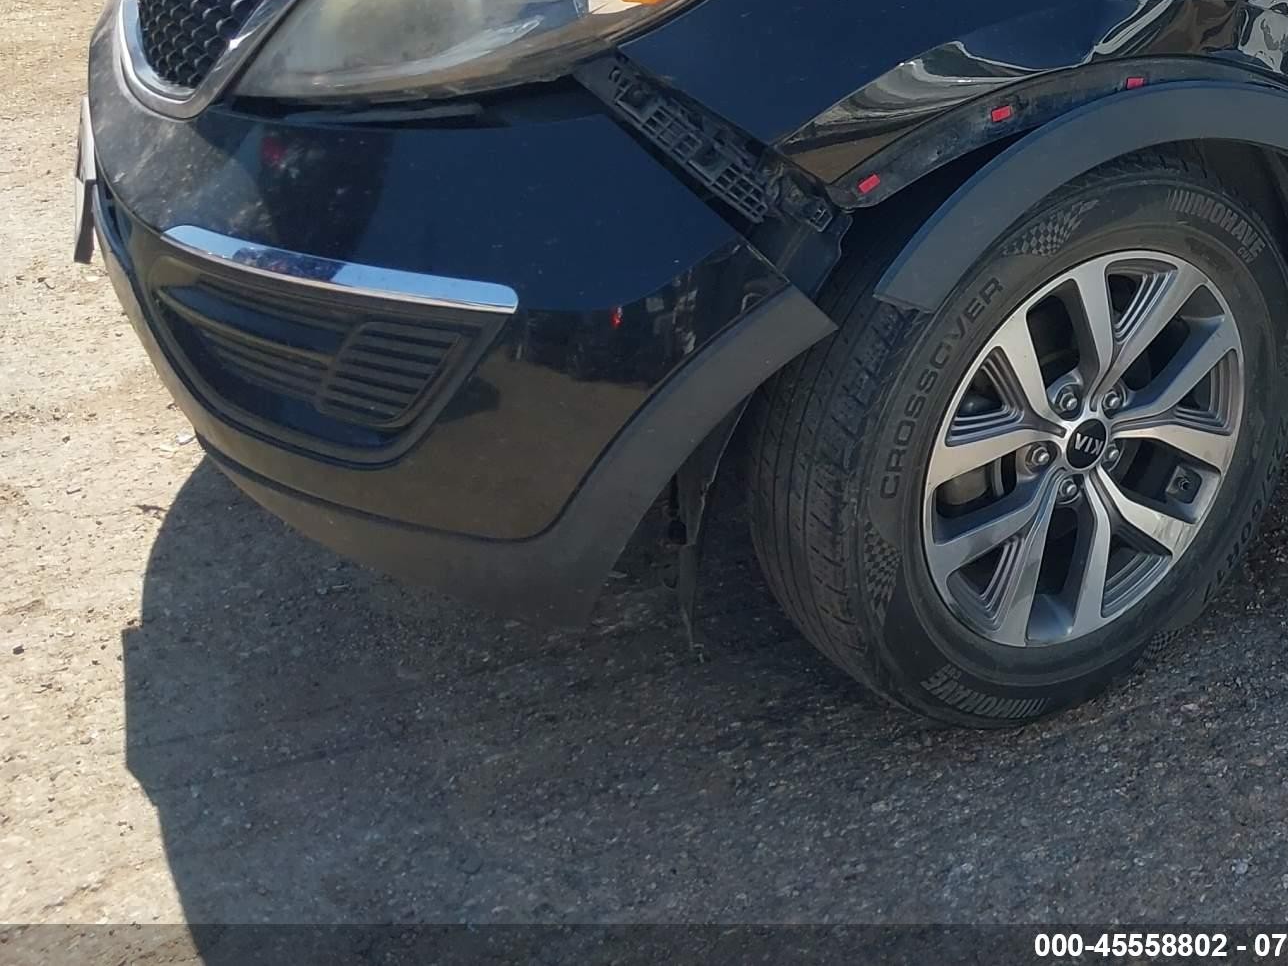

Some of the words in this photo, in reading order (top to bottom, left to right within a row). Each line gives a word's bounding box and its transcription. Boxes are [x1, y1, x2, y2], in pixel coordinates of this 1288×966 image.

[1189, 192, 1266, 258] MOHAVE
[880, 277, 1003, 498] CROSSOVER
[1074, 432, 1104, 455] KIA
